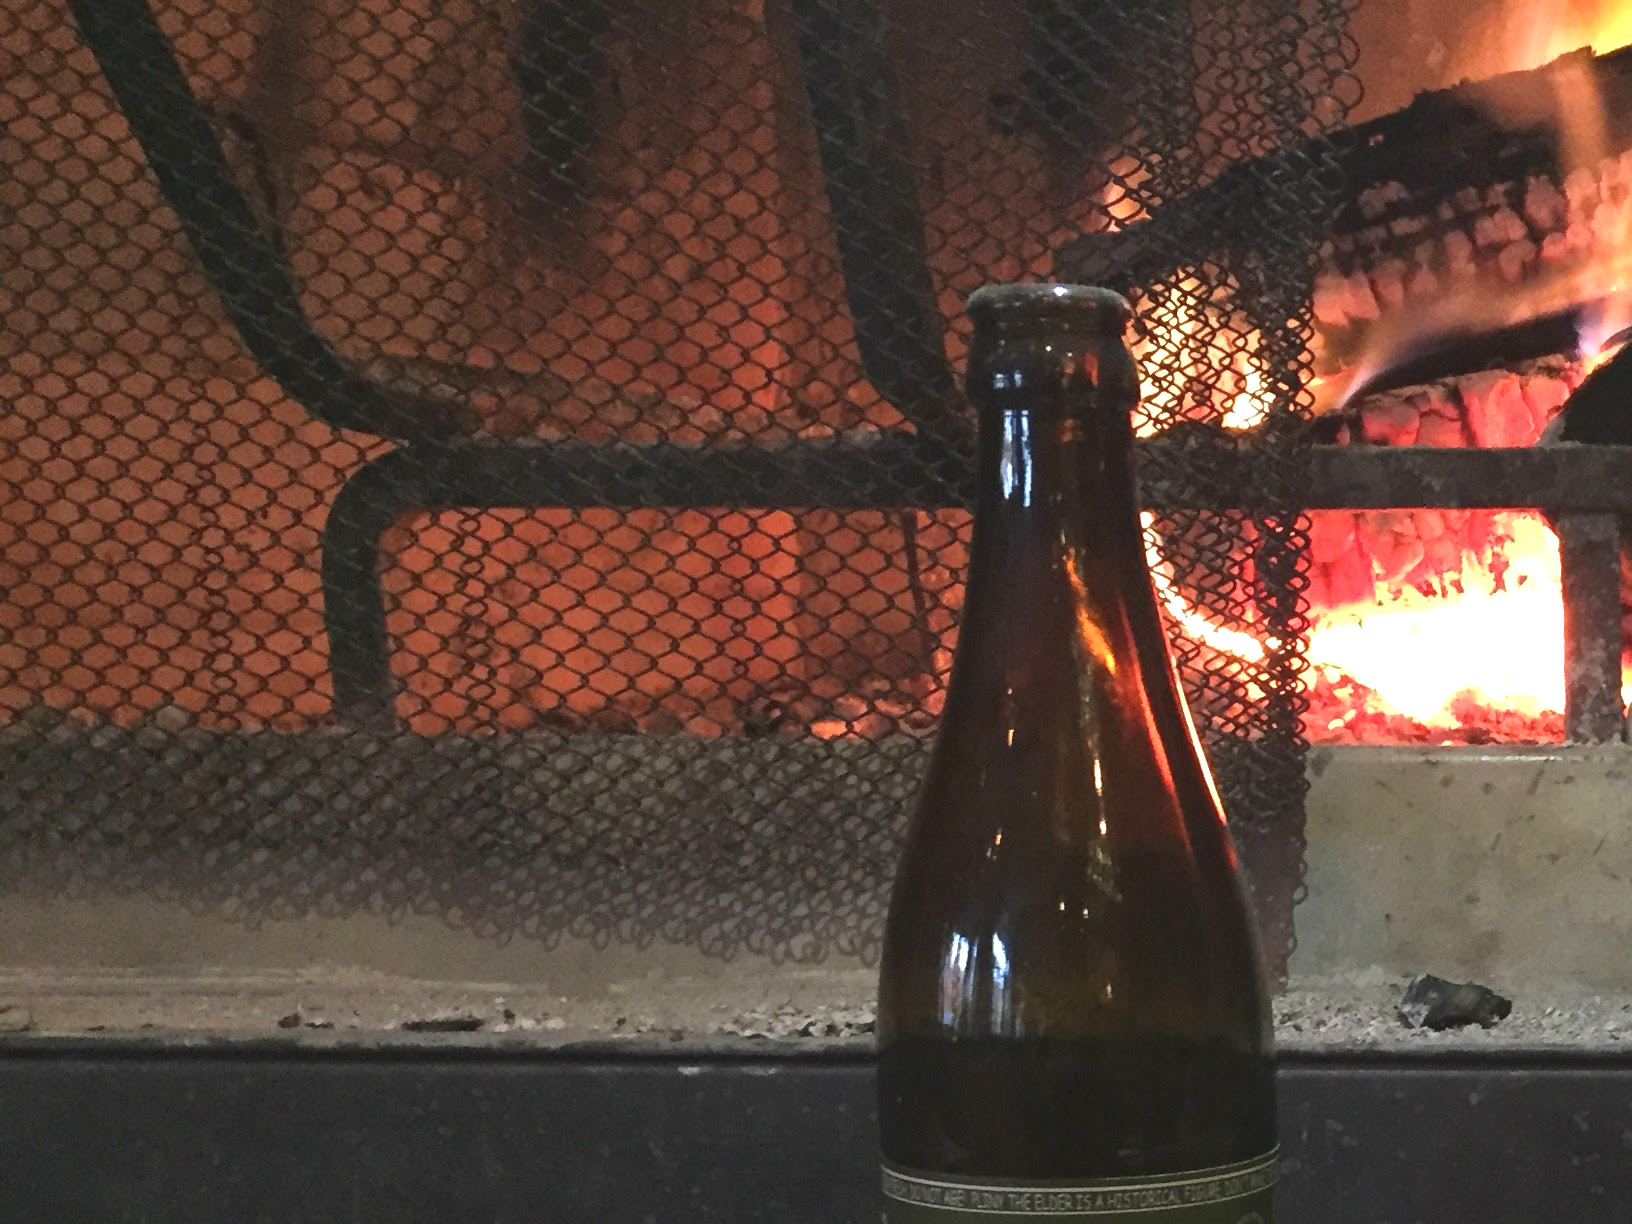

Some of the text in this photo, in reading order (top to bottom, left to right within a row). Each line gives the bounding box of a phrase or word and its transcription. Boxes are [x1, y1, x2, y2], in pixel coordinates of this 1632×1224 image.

[1007, 1193, 1031, 1209] THE
[1034, 1193, 1073, 1209] ELDER
[1075, 1192, 1091, 1209] IS
[1095, 1192, 1104, 1208] A
[1107, 1187, 1181, 1207] HISTORICAL
